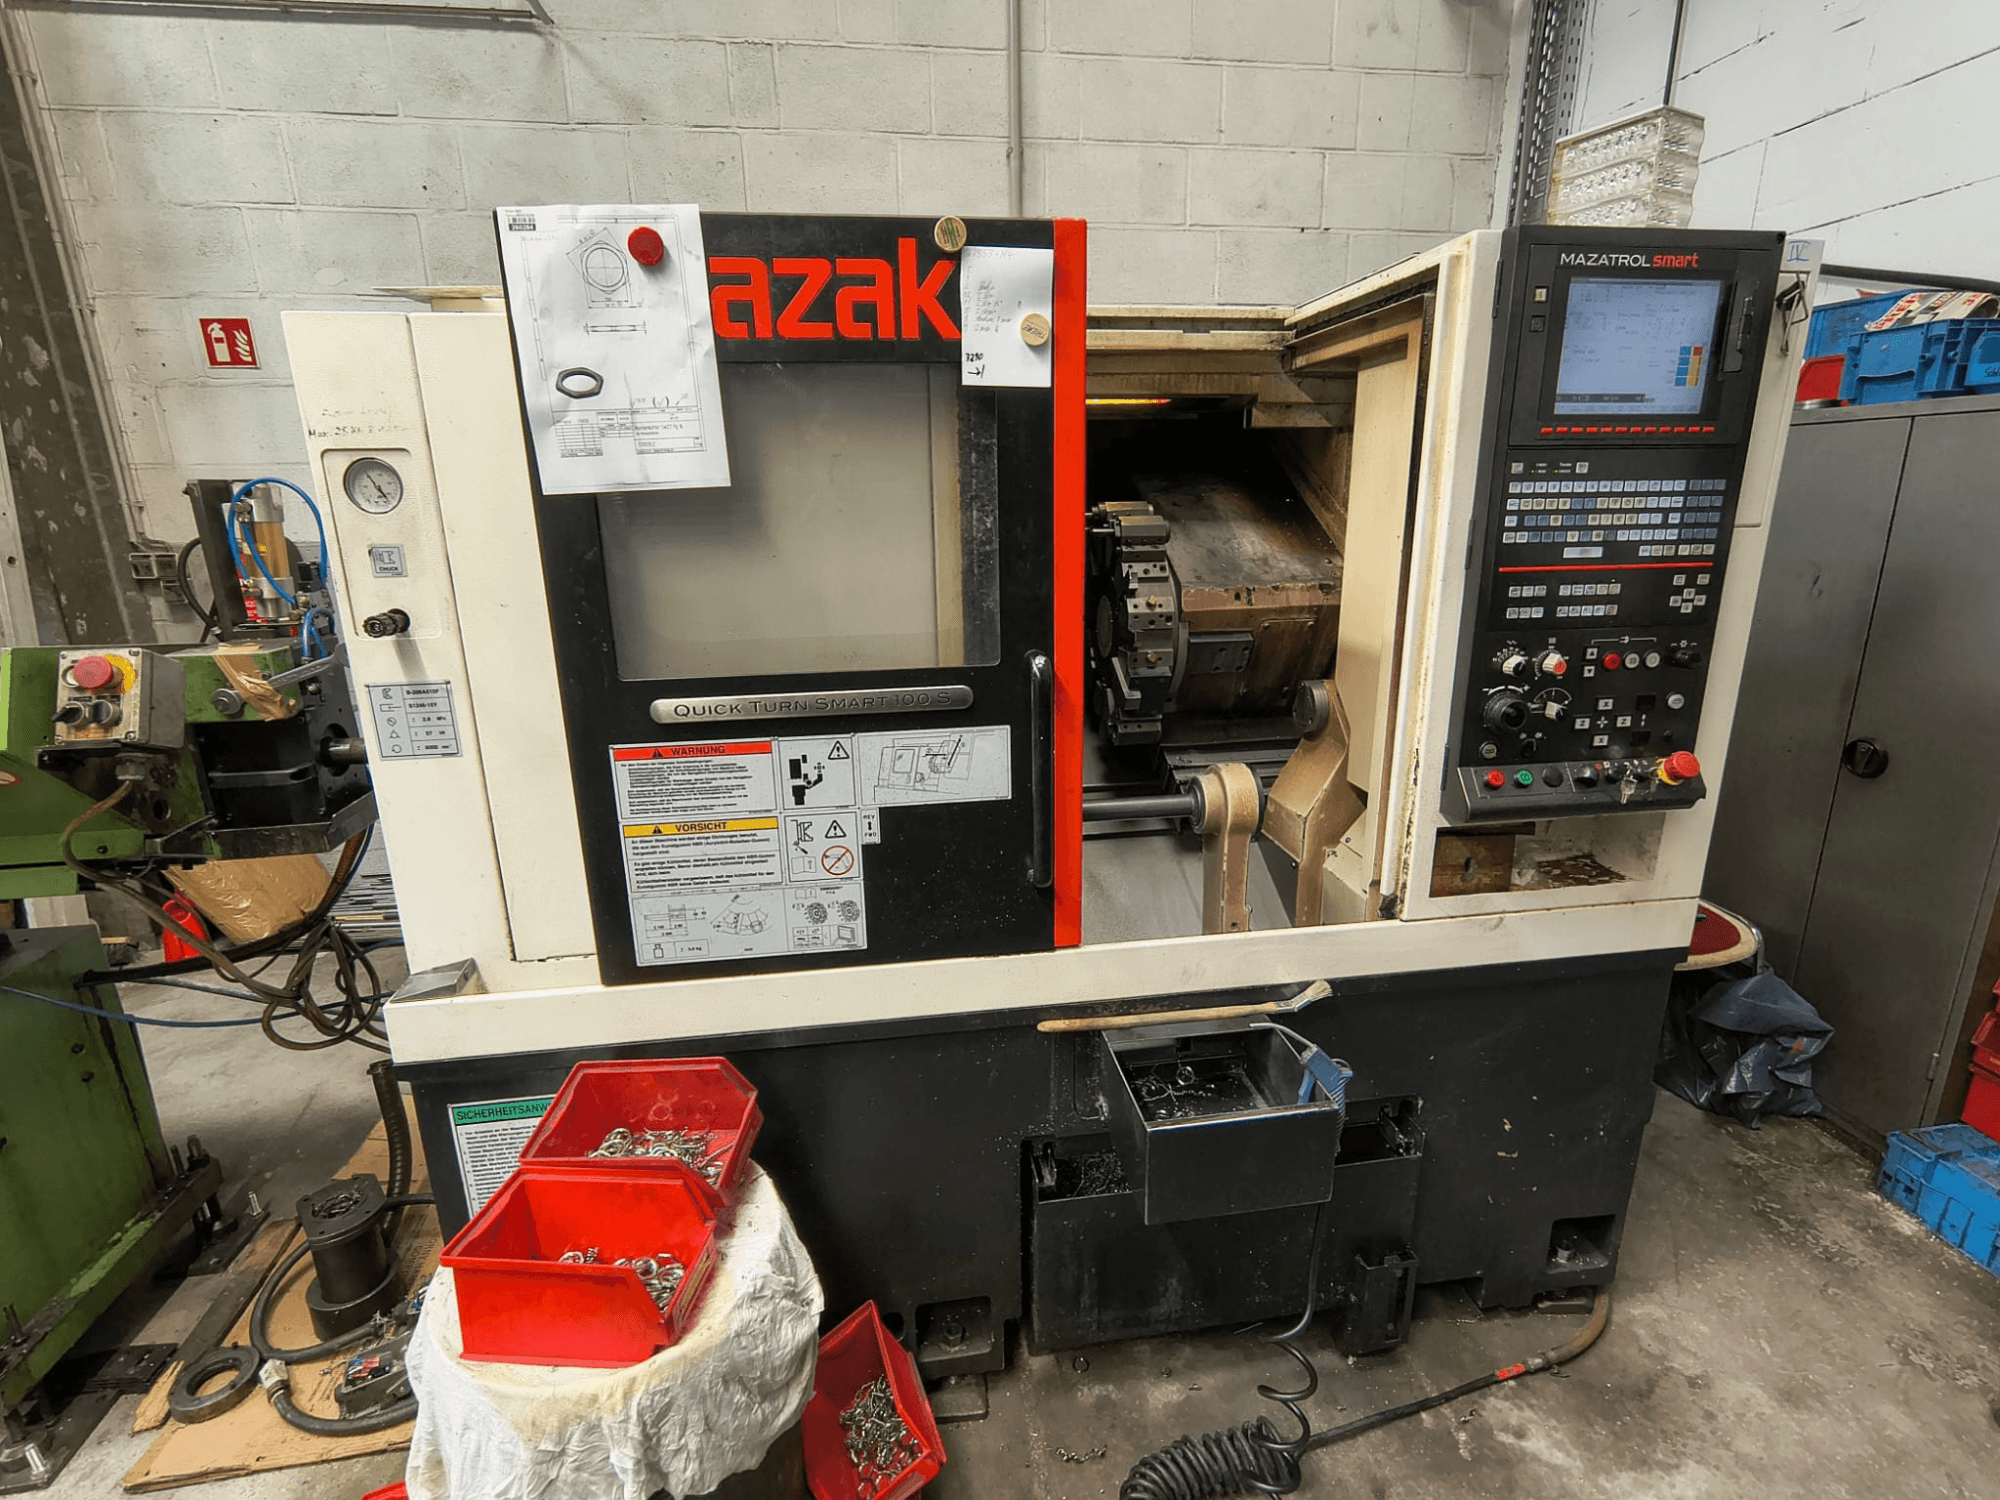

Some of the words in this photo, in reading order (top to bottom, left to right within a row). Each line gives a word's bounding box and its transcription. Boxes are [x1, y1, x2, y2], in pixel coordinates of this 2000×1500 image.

[1560, 253, 1650, 267] MAZATROL
[1653, 252, 1699, 268] smart
[709, 237, 962, 339] azak
[674, 704, 742, 718] QUICK
[749, 700, 808, 714] TURN
[815, 696, 889, 711] SMART
[895, 694, 930, 706] 100
[937, 692, 951, 704] S
[671, 745, 726, 756] WARNUNG
[675, 822, 728, 832] VORSICHT
[456, 1103, 548, 1120] SICHERHEITSANW
